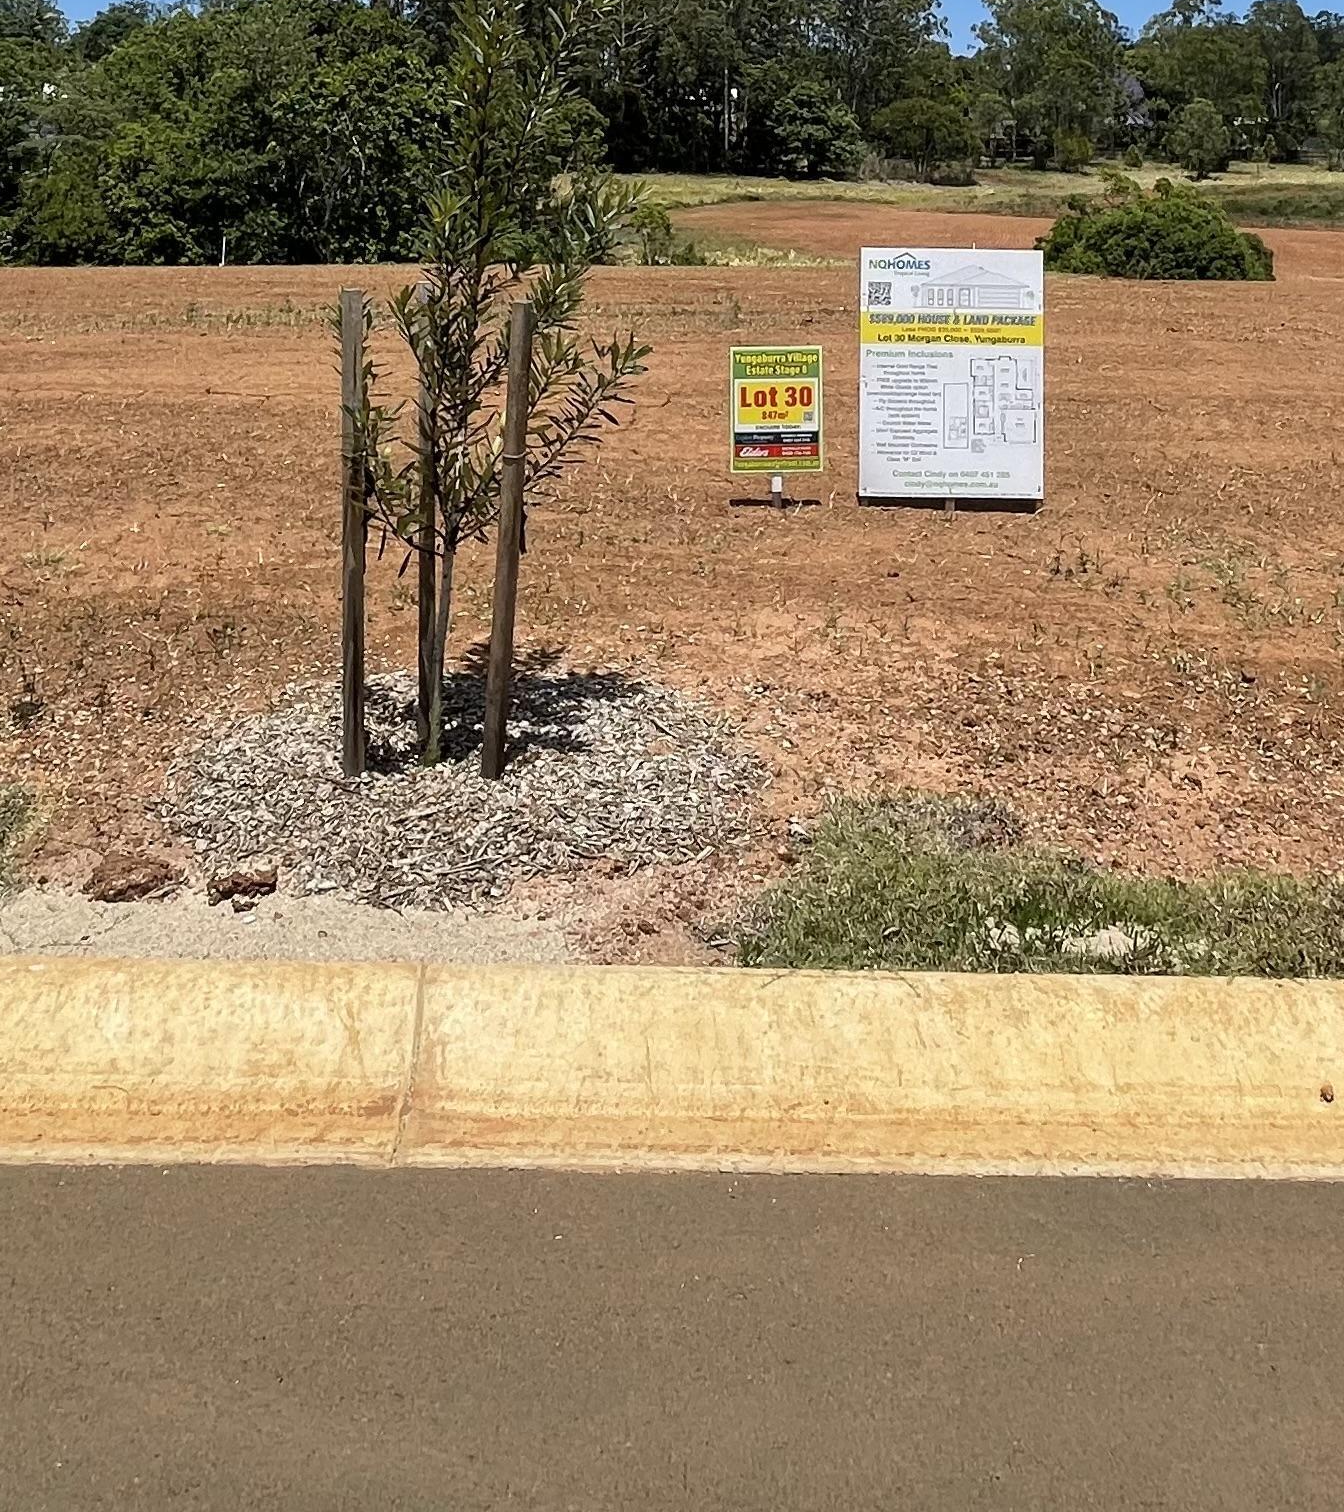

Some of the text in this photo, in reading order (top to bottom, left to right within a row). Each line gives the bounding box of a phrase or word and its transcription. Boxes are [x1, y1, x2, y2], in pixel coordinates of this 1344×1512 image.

[868, 259, 931, 270] NQHOMES
[918, 314, 951, 325] HOUSE
[963, 314, 990, 326] LAND
[991, 315, 1036, 326] PACKAGE
[877, 333, 892, 343] Lot
[894, 334, 906, 342] 30
[907, 334, 941, 344] Morgan
[974, 334, 1026, 345] Yungaburra
[735, 352, 818, 365] Yungaburra Village
[865, 349, 954, 359] Premium Inclusions
[746, 365, 774, 376] Estate
[774, 365, 801, 376] Stage
[740, 386, 812, 407] Lot 30
[892, 470, 922, 478] Contact
